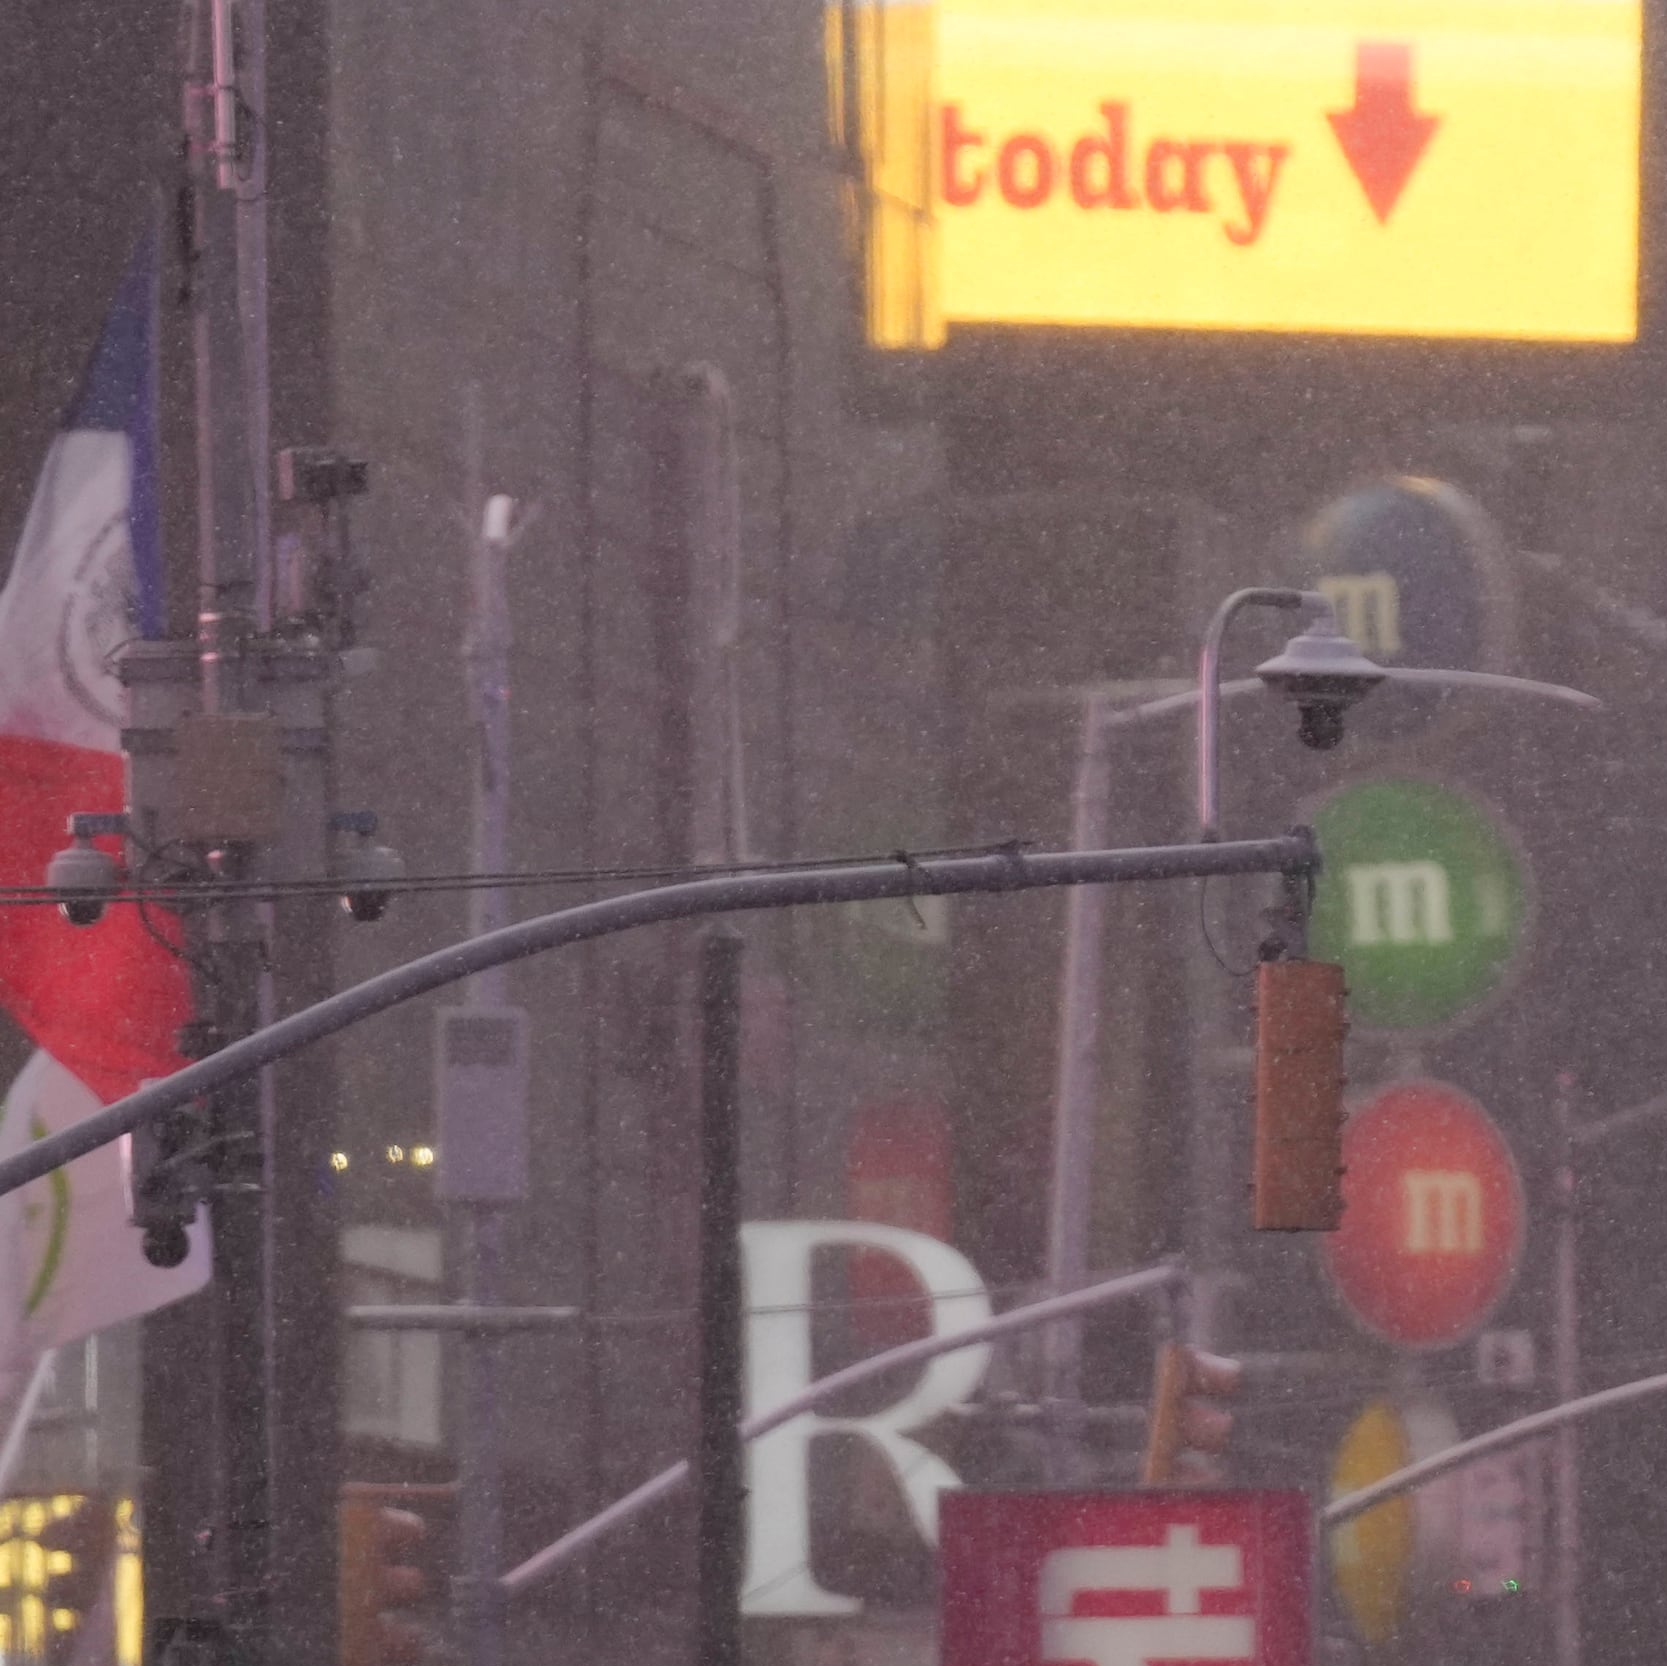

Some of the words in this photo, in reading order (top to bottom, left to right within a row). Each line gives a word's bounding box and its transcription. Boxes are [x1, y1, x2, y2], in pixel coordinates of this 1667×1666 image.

[941, 101, 1292, 247] today
[1344, 859, 1454, 948] m
[1401, 1168, 1486, 1255] m
[741, 1220, 993, 1617] R
